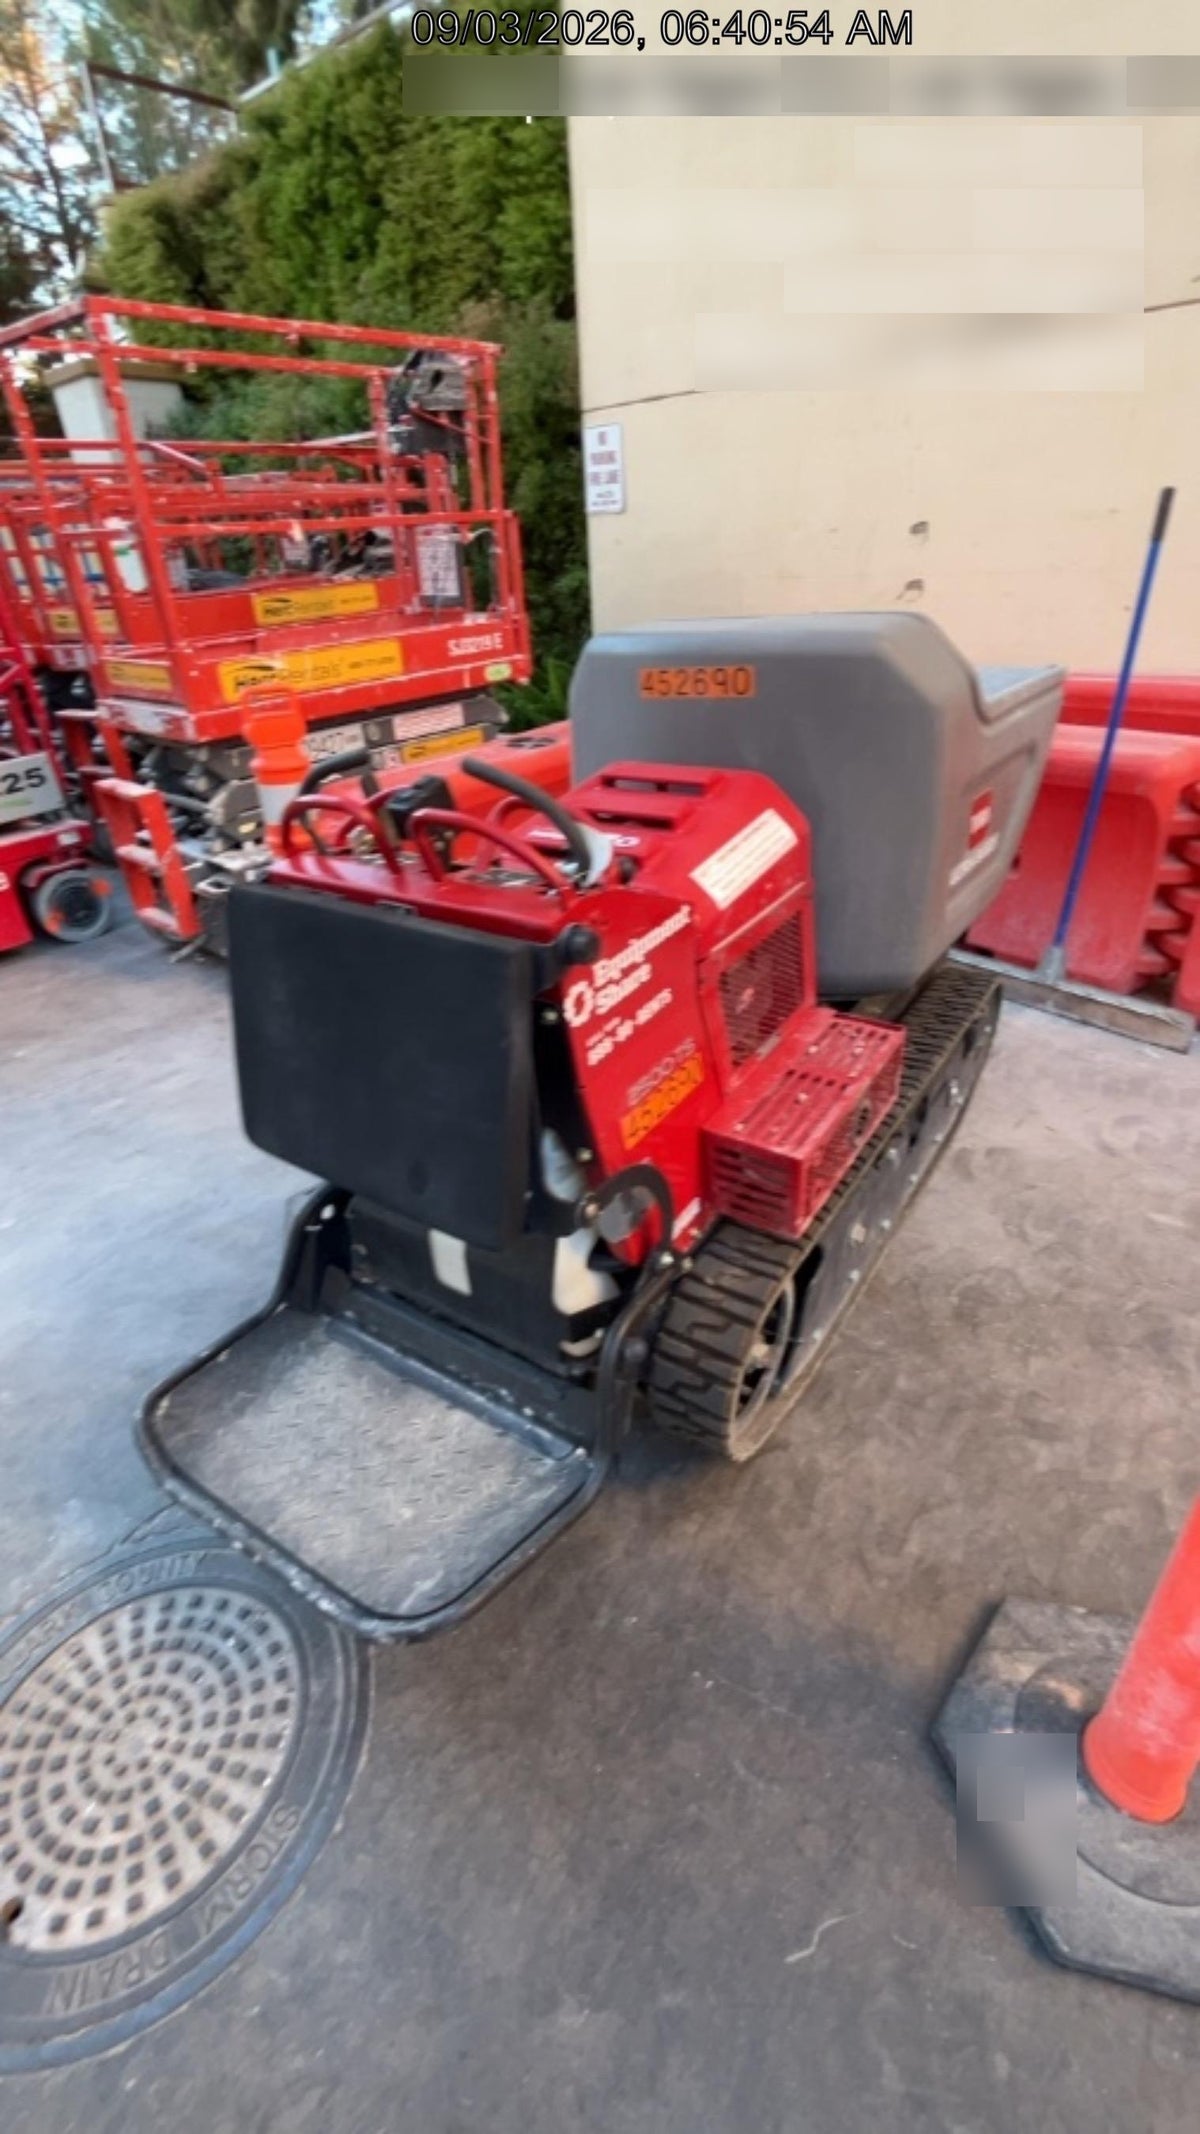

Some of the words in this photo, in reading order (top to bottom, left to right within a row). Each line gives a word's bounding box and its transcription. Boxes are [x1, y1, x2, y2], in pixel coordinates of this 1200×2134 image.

[642, 667, 751, 696] 452690
[0, 767, 47, 797] 25
[204, 1804, 301, 1936] STORM
[45, 1930, 171, 2013] DRAIN
